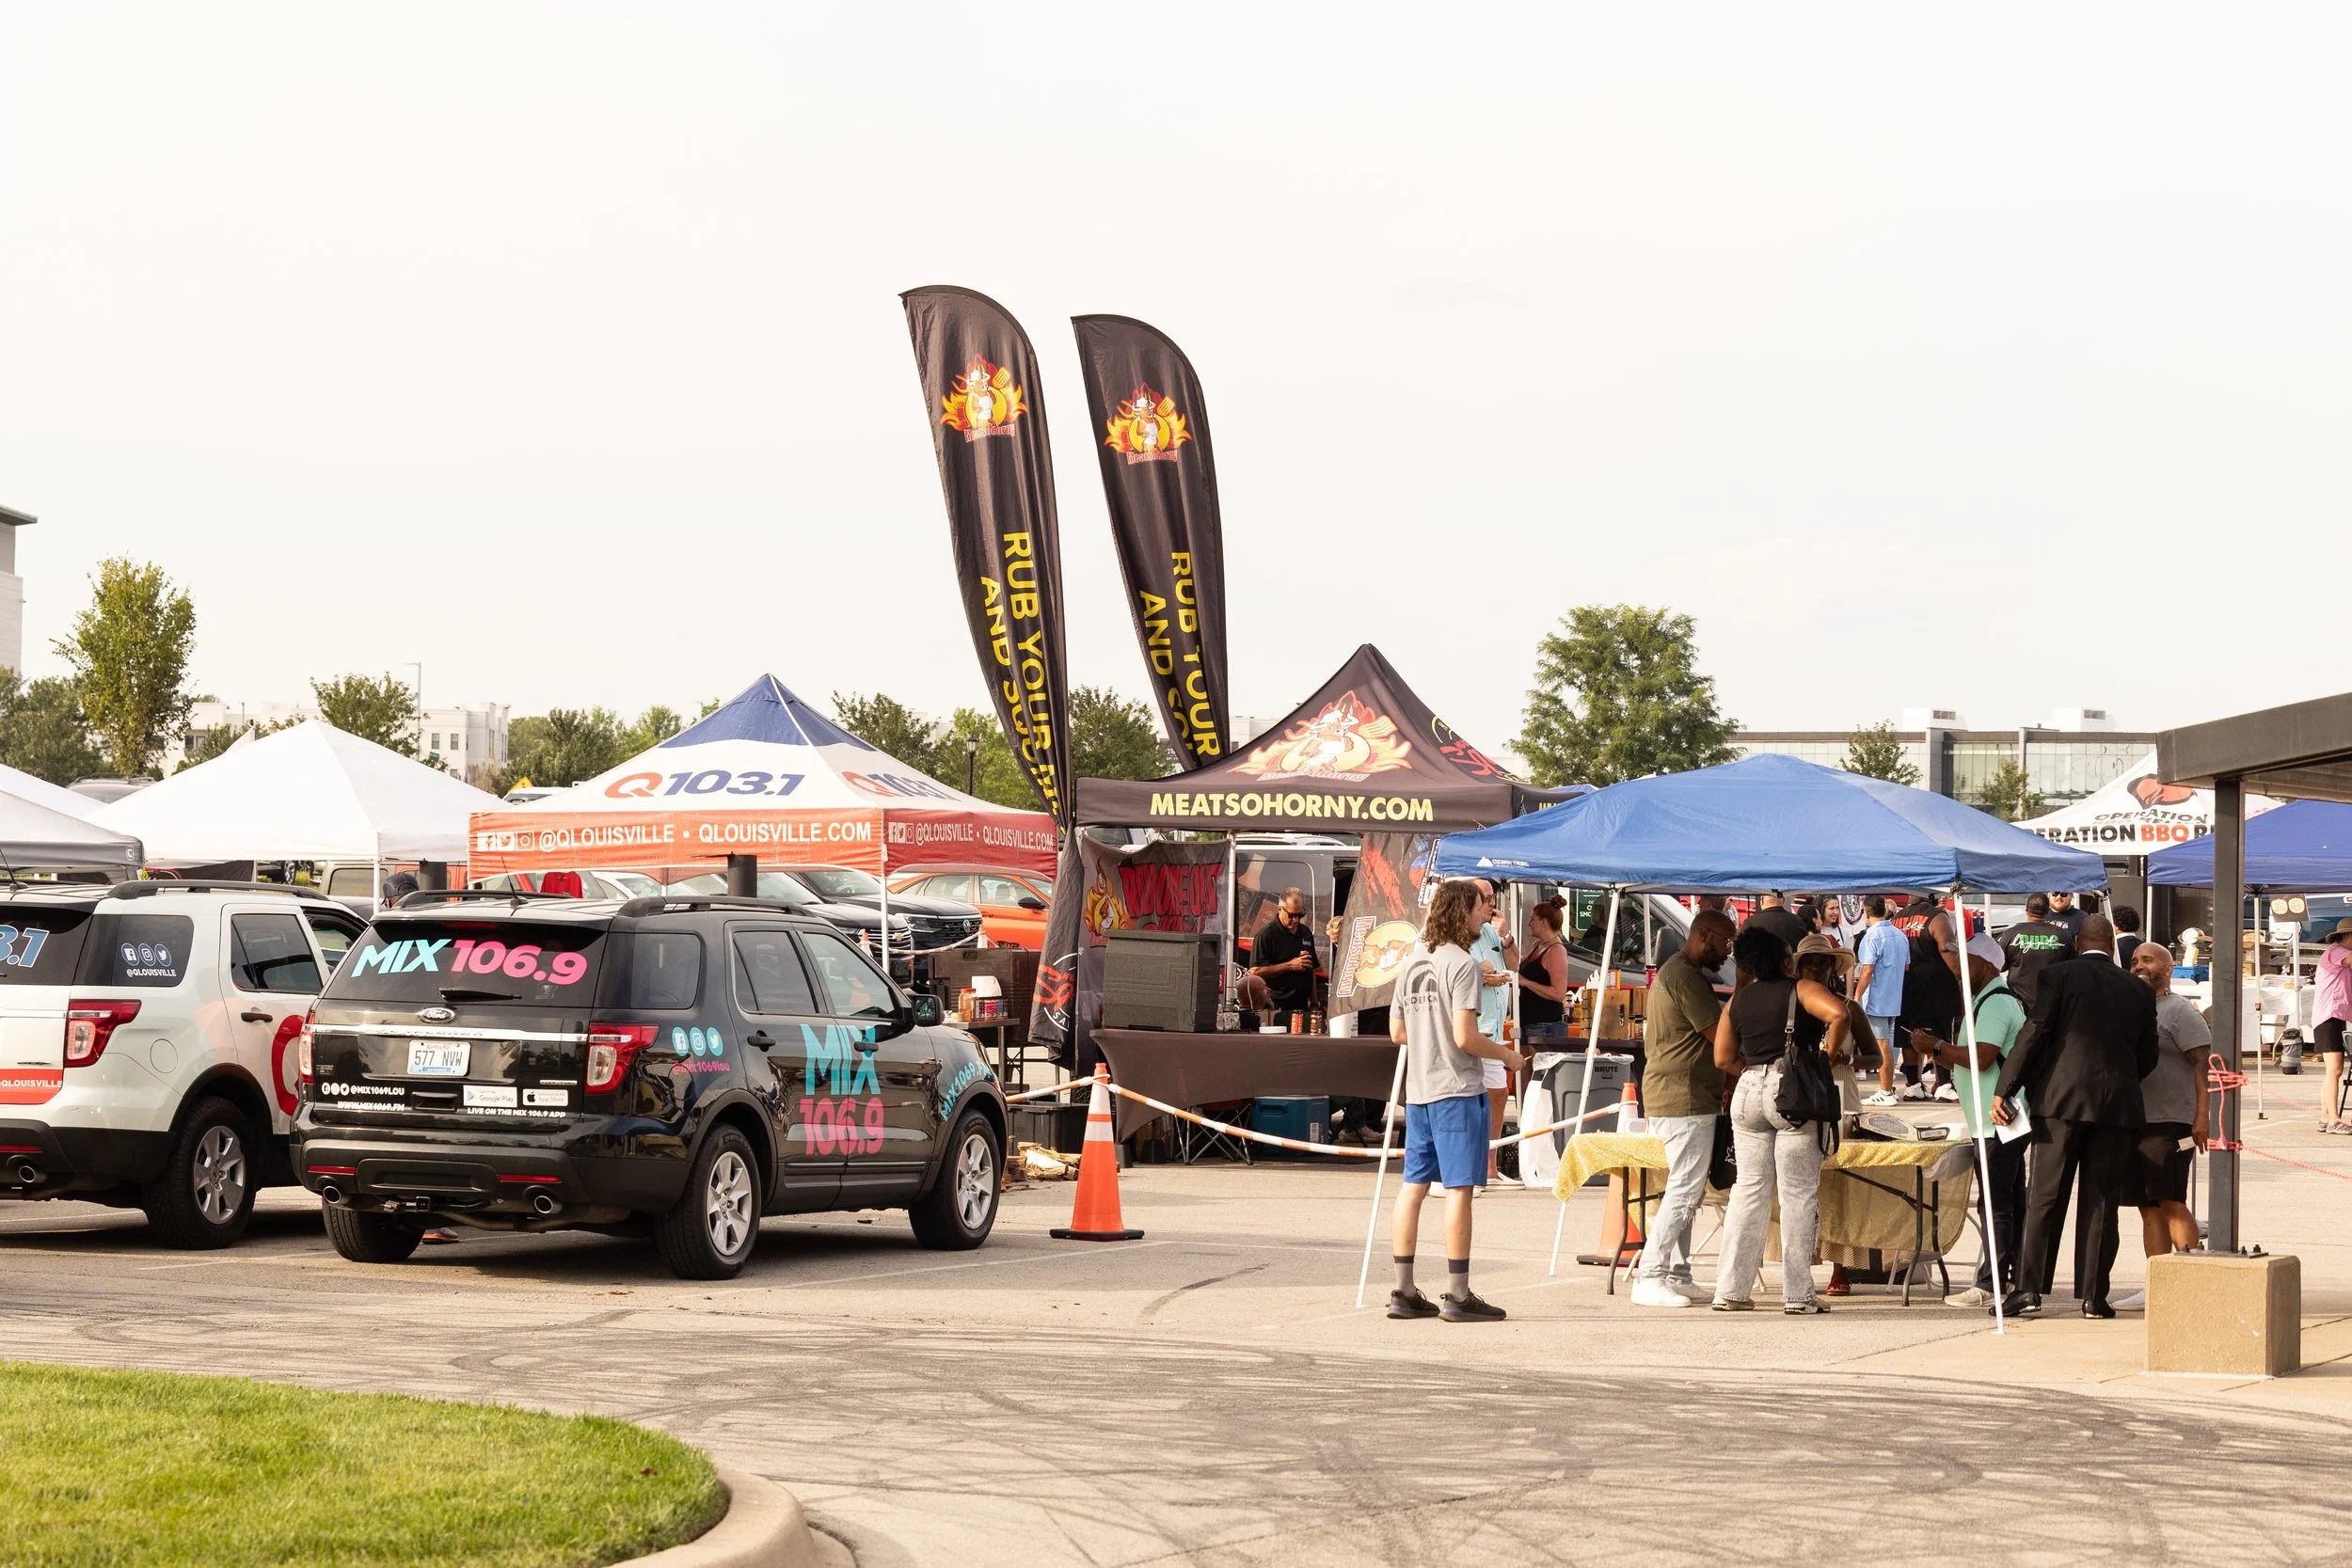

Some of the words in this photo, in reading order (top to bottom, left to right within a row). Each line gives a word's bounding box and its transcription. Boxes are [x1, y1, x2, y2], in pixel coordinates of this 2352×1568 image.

[1003, 531, 1040, 620] RUB
[1171, 551, 1199, 634] RUB
[980, 576, 1011, 667] AND
[1139, 590, 1173, 676] AND
[1017, 630, 1052, 752] YOUR
[604, 769, 806, 799] Q103.1
[1150, 792, 1435, 822] MEATSOHORNY.COM
[2094, 808, 2208, 824] OPERATION
[539, 824, 675, 853] @QLOUISVILLE
[698, 821, 871, 844] QLOUISVILLE.COM
[915, 823, 974, 847] @QLOUISVILLE
[983, 825, 1055, 851] QLOUISVILLE.COM
[2140, 824, 2189, 843] BBQ
[126, 968, 177, 977] @QLOUISVILLE
[350, 939, 452, 978] MIX
[450, 940, 588, 986] 106.9
[414, 1050, 436, 1066] 577
[441, 1051, 463, 1067] NVW
[800, 1023, 882, 1096] MIX
[350, 1085, 405, 1096] @MIX1069LOU
[479, 1094, 501, 1103] Google
[501, 1095, 514, 1103] Play
[800, 1097, 884, 1156] 106.9
